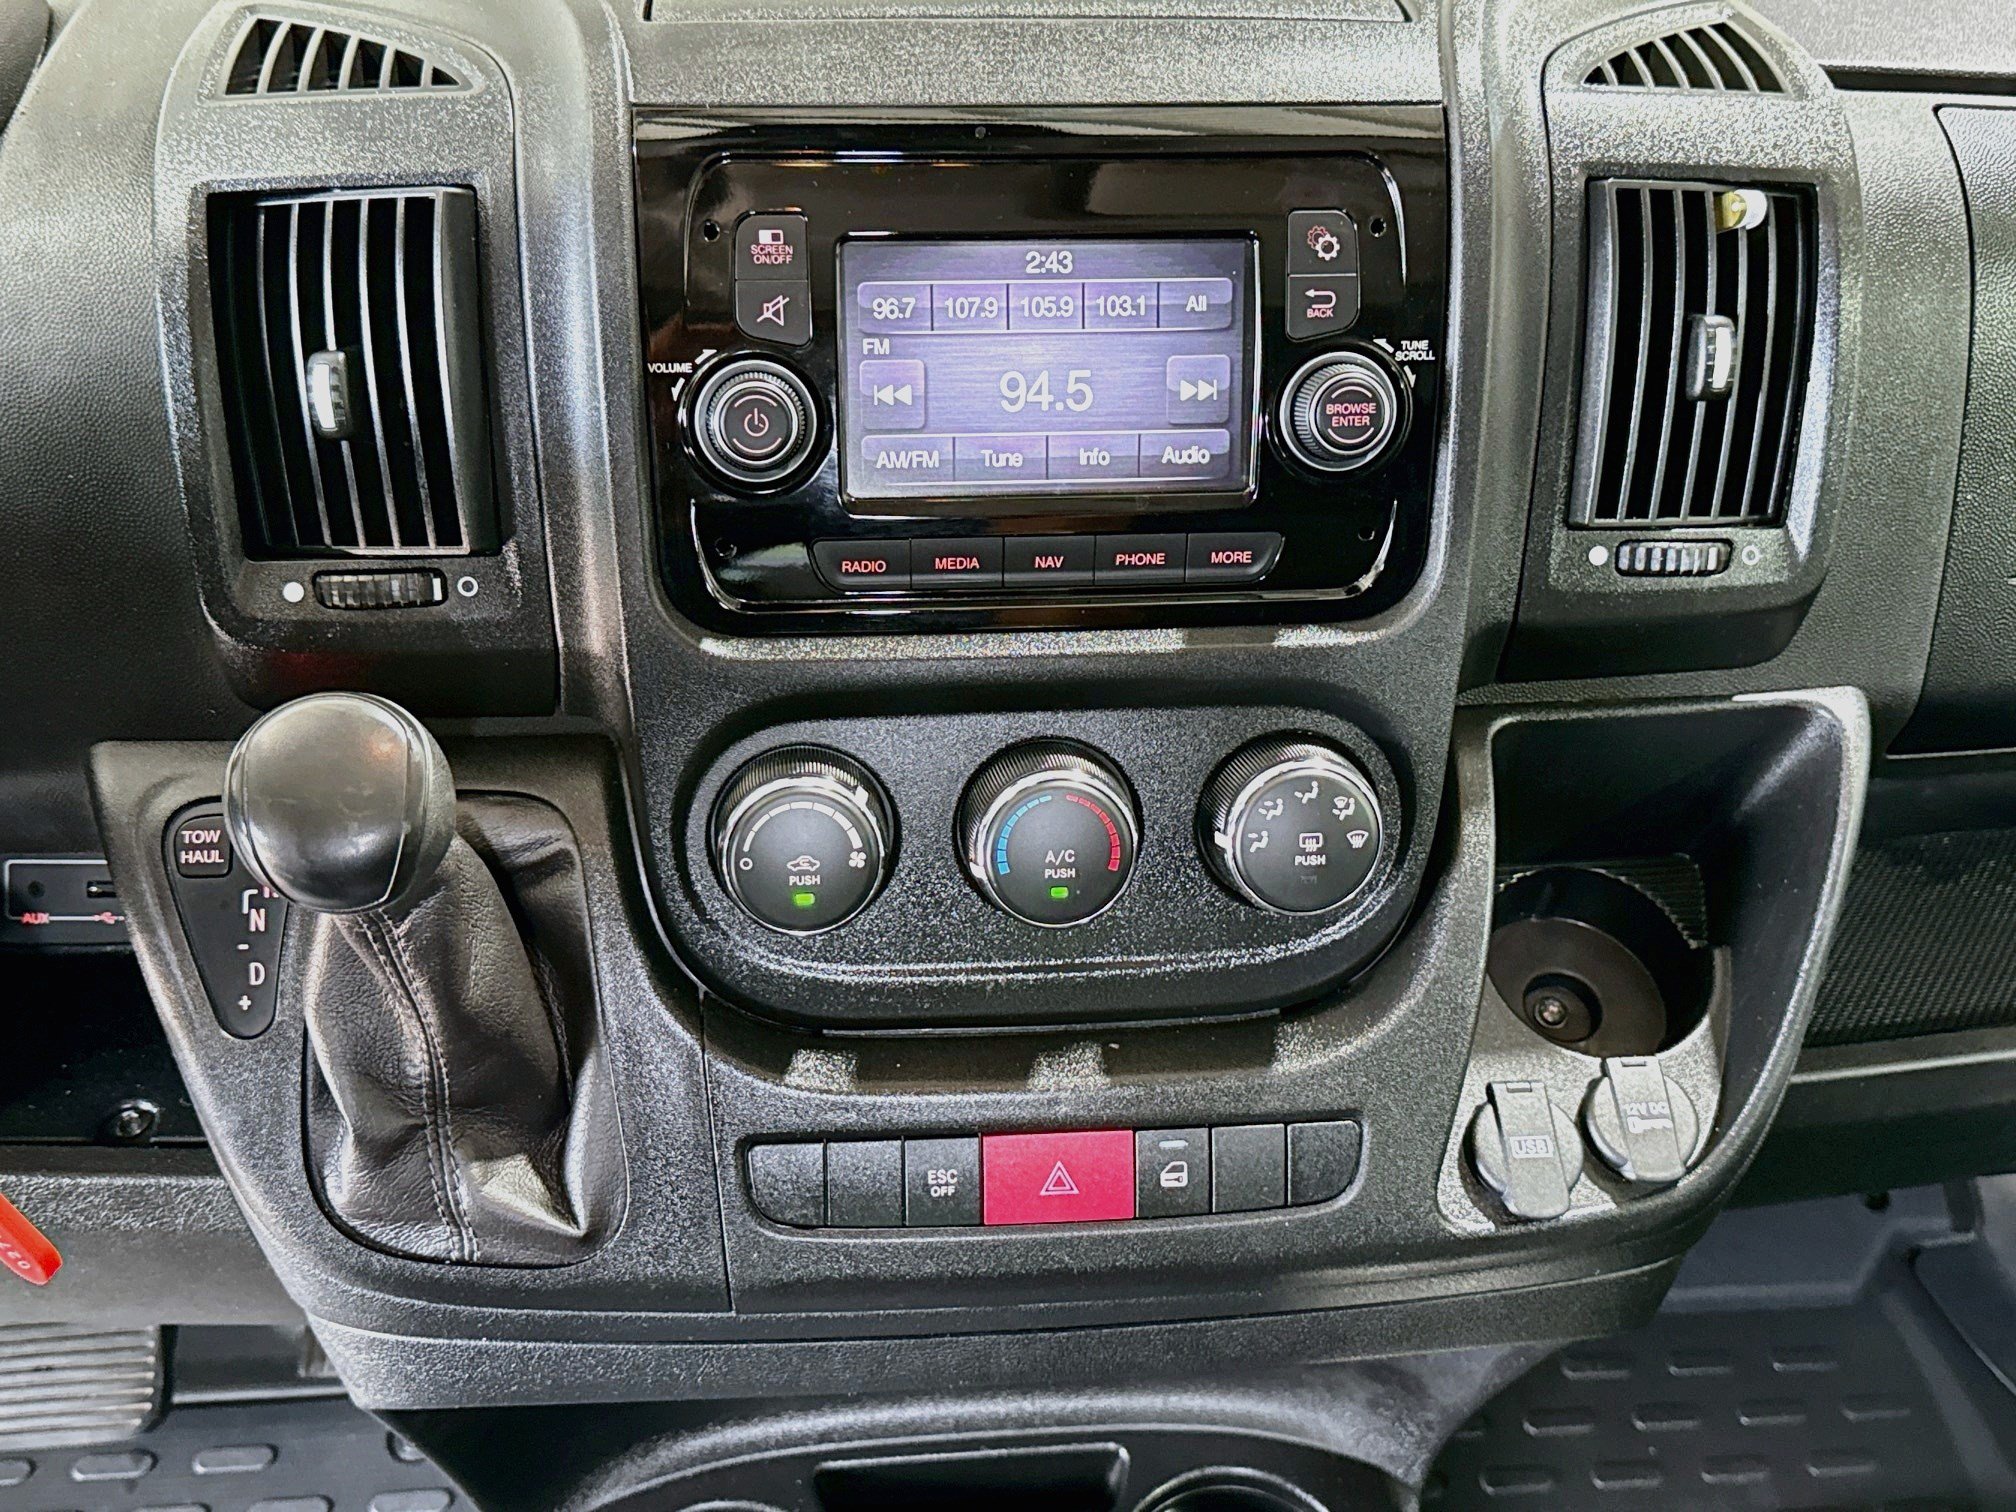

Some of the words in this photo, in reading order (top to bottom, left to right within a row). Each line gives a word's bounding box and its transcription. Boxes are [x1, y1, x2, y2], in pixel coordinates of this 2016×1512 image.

[750, 244, 793, 255] SCREEN
[753, 254, 792, 265] ON/OFF
[1025, 250, 1073, 274] 2:43
[872, 297, 916, 320] 96.7
[944, 297, 999, 319] 107.9
[1020, 296, 1074, 318] 105.9
[1096, 295, 1147, 317] 103.1
[1185, 295, 1207, 312] All
[1306, 308, 1334, 318] BACK
[862, 338, 890, 355] FM
[1401, 340, 1429, 350] TUNE
[1394, 350, 1435, 361] SCROLL
[648, 362, 692, 373] VOLUME
[1000, 369, 1094, 413] 94.5
[1325, 402, 1376, 414] BROWSE
[1331, 415, 1370, 427] ENTER
[876, 450, 939, 469] AM/FM
[980, 449, 1023, 468] Tune
[1079, 447, 1110, 466] Info
[1162, 446, 1210, 465] Audio
[934, 557, 980, 570] MEDIA
[1034, 556, 1064, 569] NAV
[1115, 552, 1165, 566] PHONE
[1211, 551, 1252, 564] MORE
[841, 559, 887, 574] RADIO
[180, 829, 221, 843] TOW
[180, 849, 224, 864] HAUL
[1044, 848, 1076, 864] A/C
[1295, 854, 1326, 866] PUSH
[1043, 866, 1076, 878] PUSH
[789, 874, 821, 886] PUSH
[21, 912, 50, 925] AUX
[249, 908, 266, 932] N
[249, 961, 266, 985] D
[1513, 1139, 1549, 1155] USB
[927, 1169, 958, 1186] ESC
[930, 1185, 956, 1197] OFF
